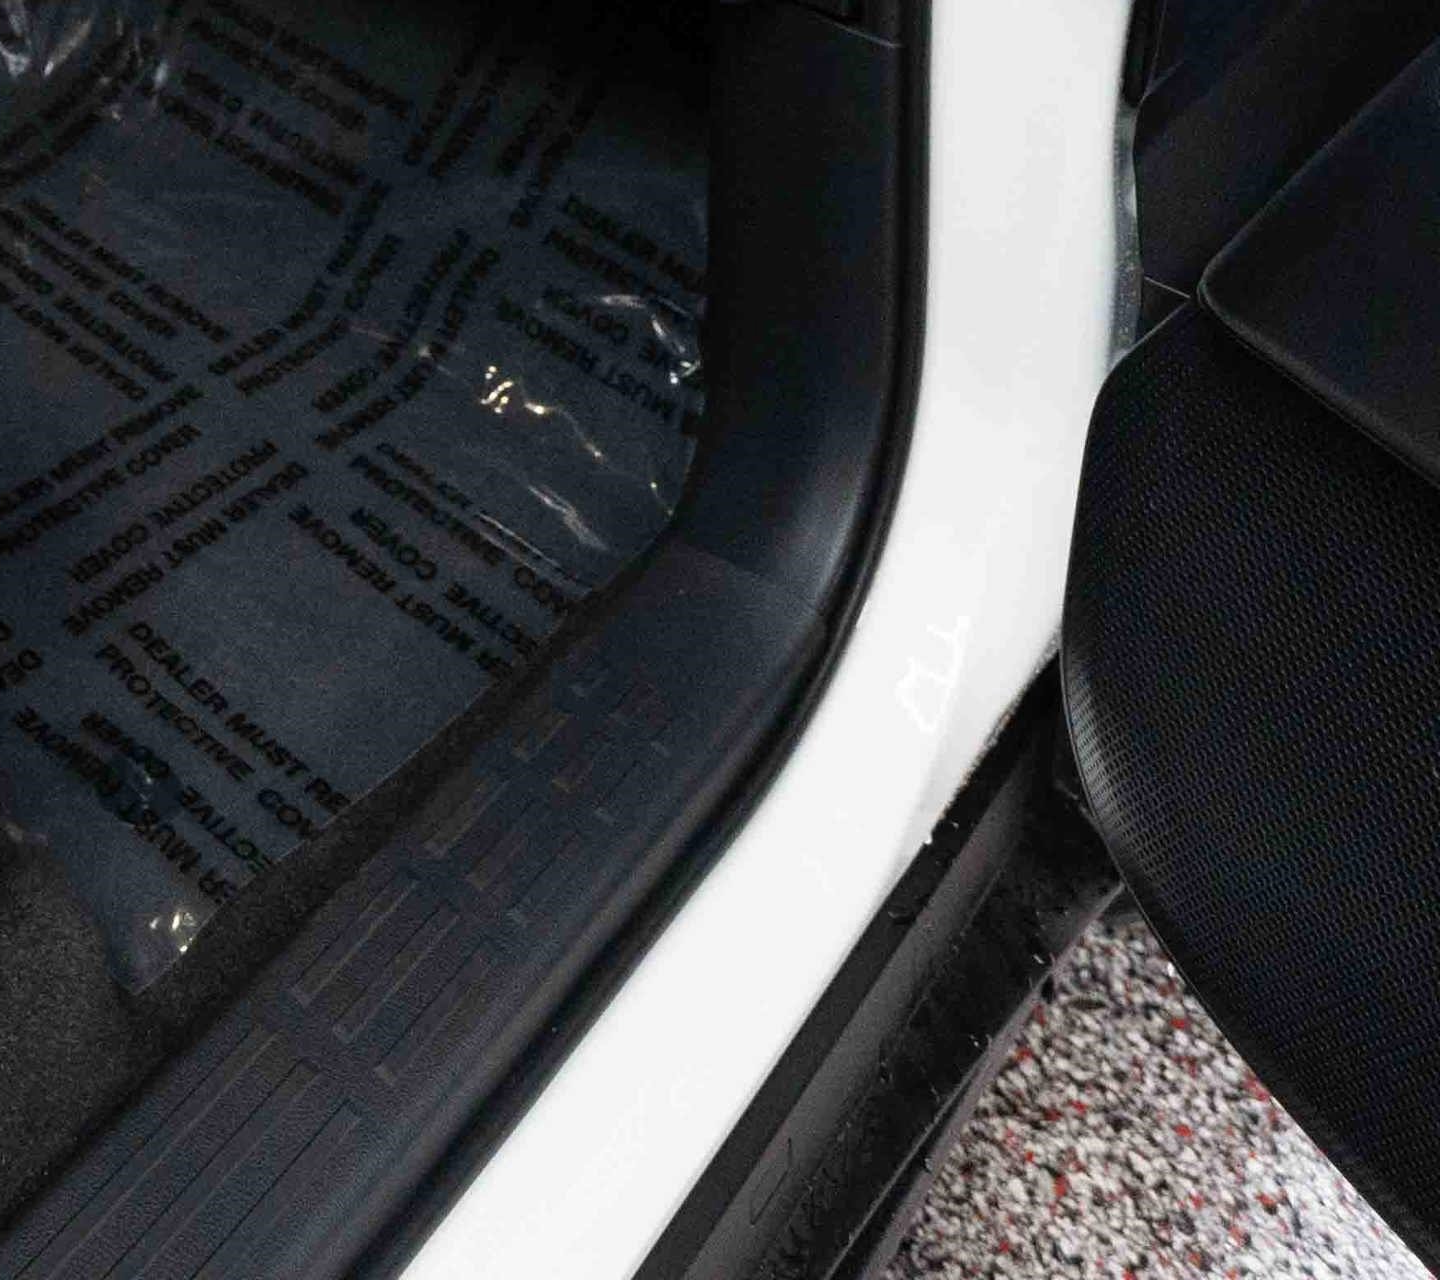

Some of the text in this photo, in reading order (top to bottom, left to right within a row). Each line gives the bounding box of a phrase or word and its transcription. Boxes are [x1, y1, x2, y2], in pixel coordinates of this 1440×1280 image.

[125, 422, 205, 478] COVER
[61, 460, 311, 637] DEALER MUST REMOVE
[66, 439, 280, 585] PROTECTIVE COVER
[287, 502, 398, 595] REMOVE
[347, 452, 507, 568] PROTECTIVE
[349, 505, 438, 581] COVER
[395, 592, 478, 654] MUST
[12, 704, 123, 800] REMOVE
[80, 710, 172, 780] COVER
[93, 642, 320, 840] PROTECTIVE COV
[127, 621, 351, 816] DEALER MUST RE
